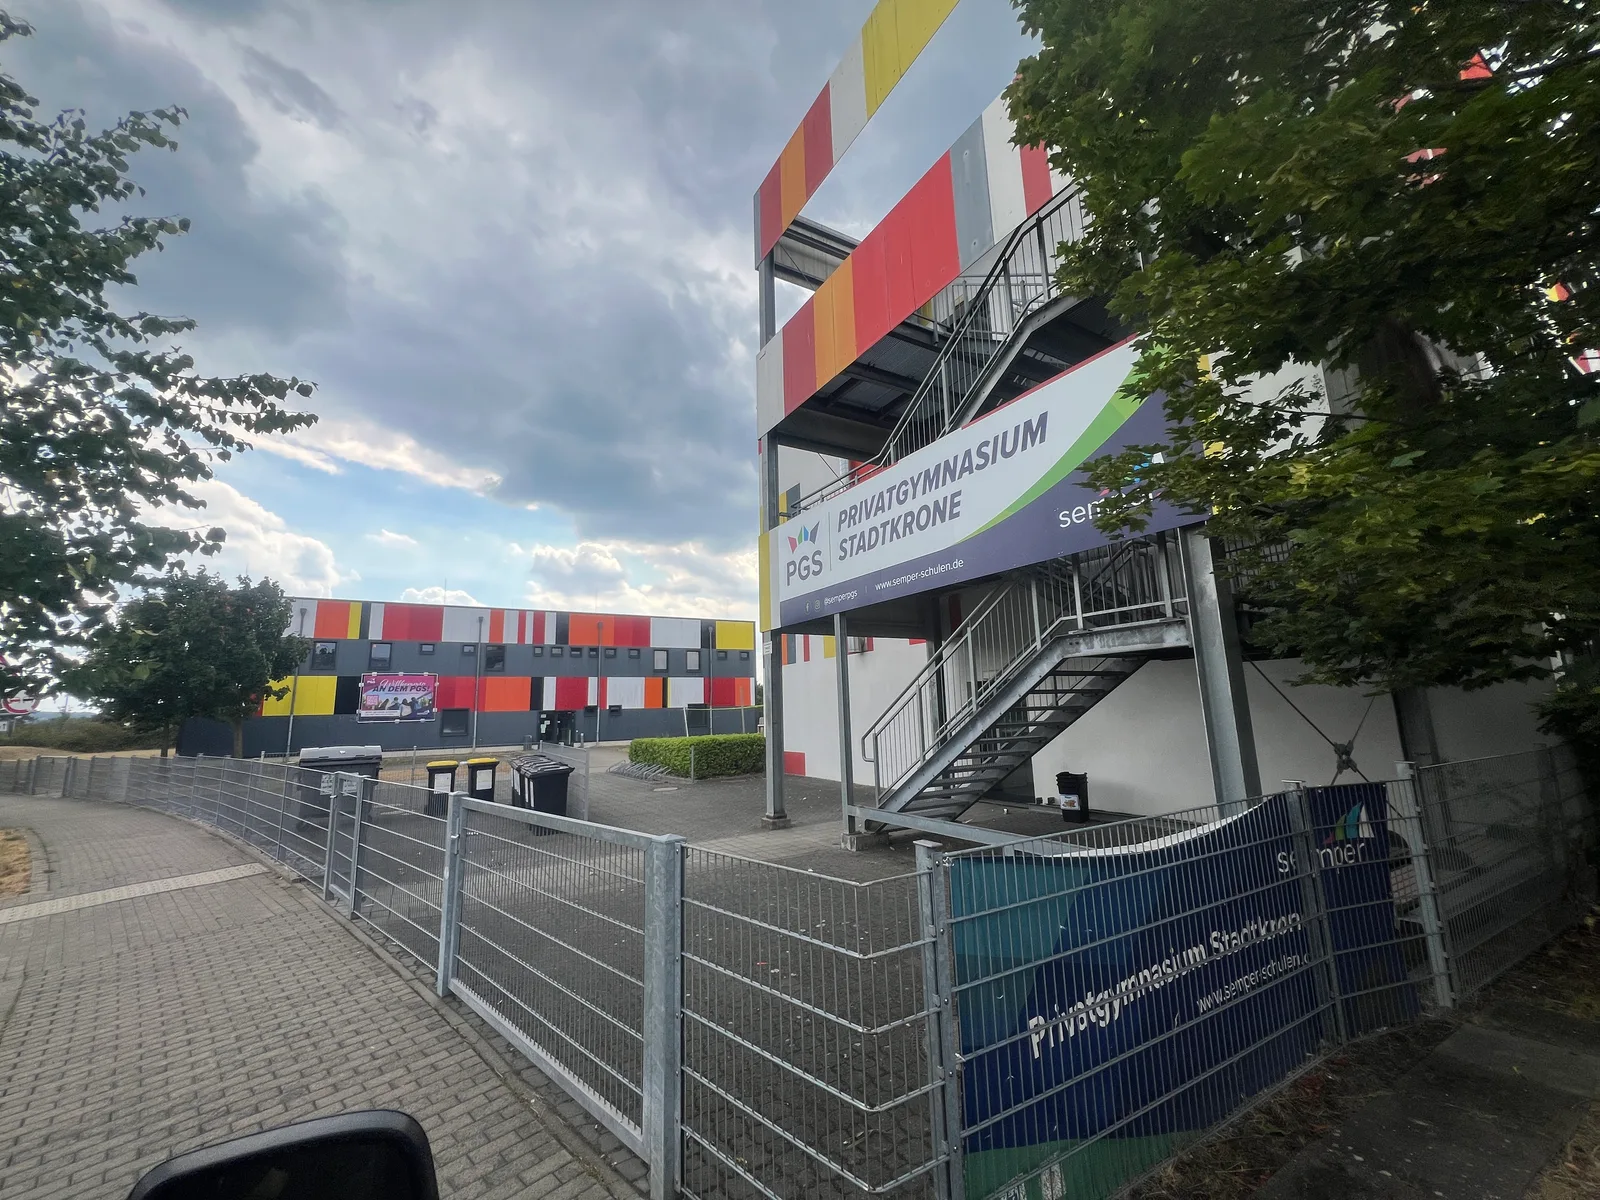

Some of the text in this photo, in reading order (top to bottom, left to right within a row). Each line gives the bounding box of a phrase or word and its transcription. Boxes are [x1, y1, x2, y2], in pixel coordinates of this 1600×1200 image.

[837, 411, 1048, 532] PRIVATGYMNASIUM
[838, 489, 962, 561] STADTKRONE
[786, 549, 823, 587] PGS
[824, 558, 964, 606] @semperpgs www.semper-schulen.de
[1028, 913, 1302, 1060] Privatgymnasium Stadtkron
